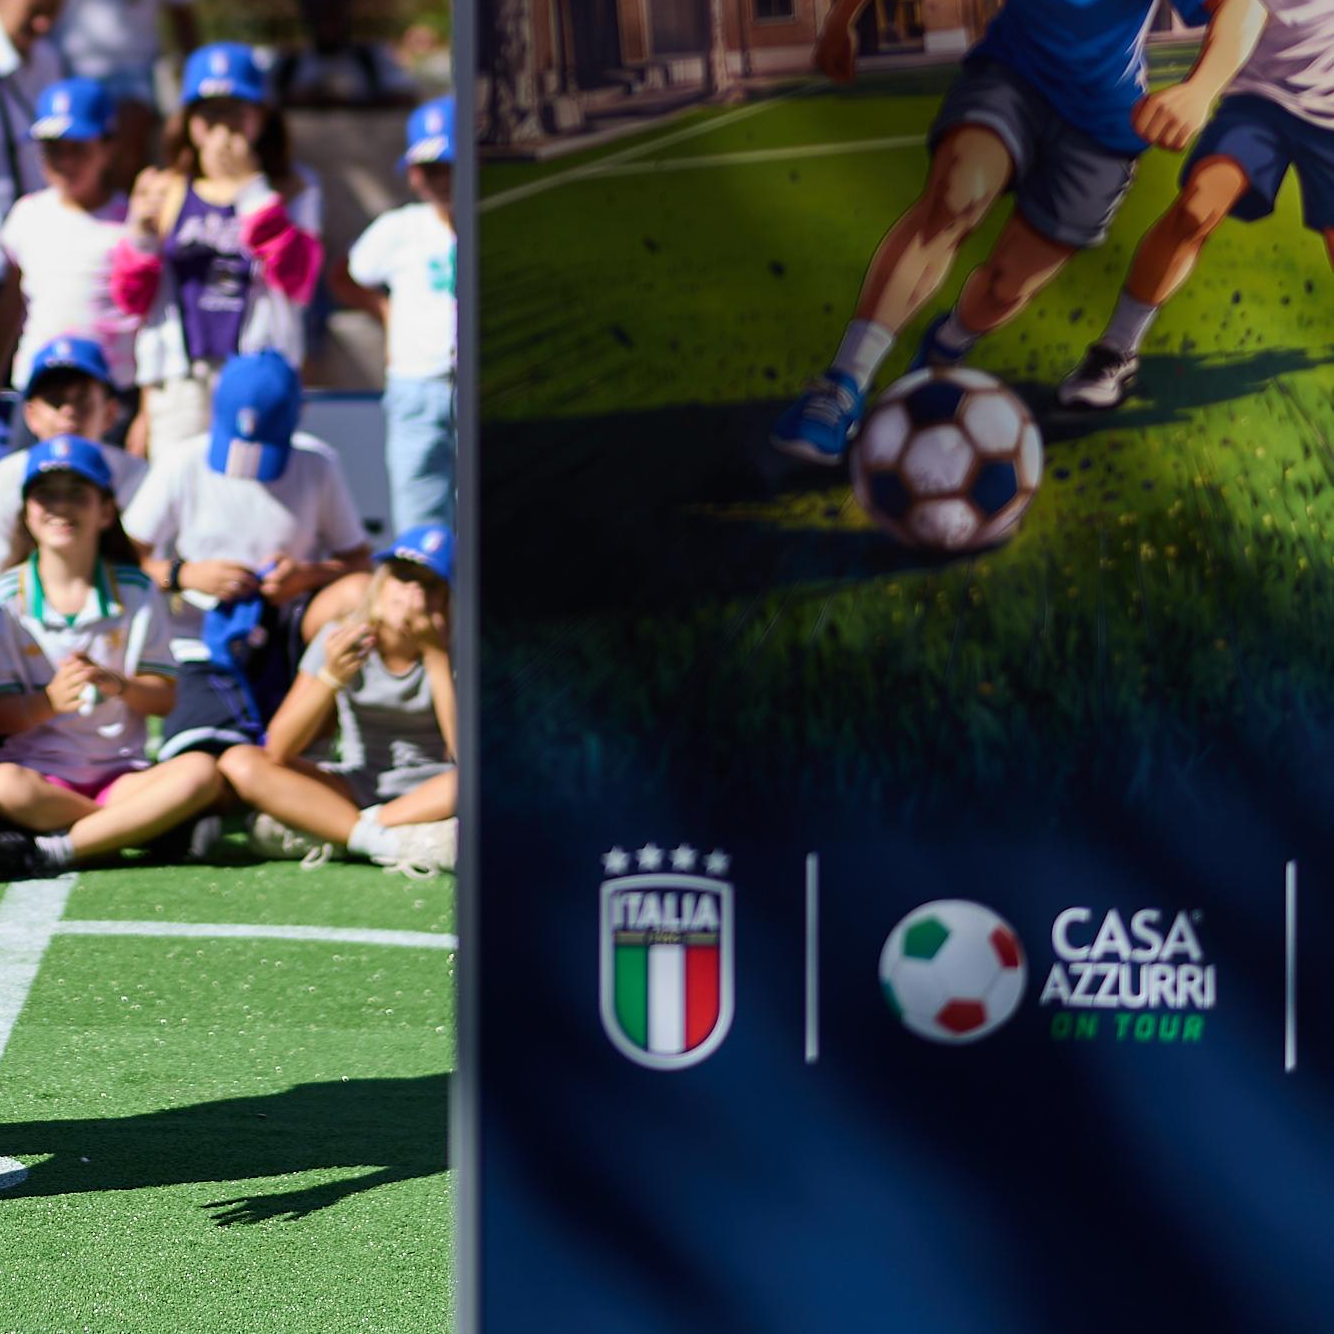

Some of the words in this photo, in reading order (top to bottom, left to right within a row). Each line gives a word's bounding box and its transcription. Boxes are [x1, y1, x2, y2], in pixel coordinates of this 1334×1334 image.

[612, 889, 721, 931] ITALIA
[1051, 906, 1204, 963] CASA
[1039, 962, 1216, 1010] AZZURRI
[1051, 1012, 1099, 1041] ON
[1114, 1012, 1205, 1043] TOUR
